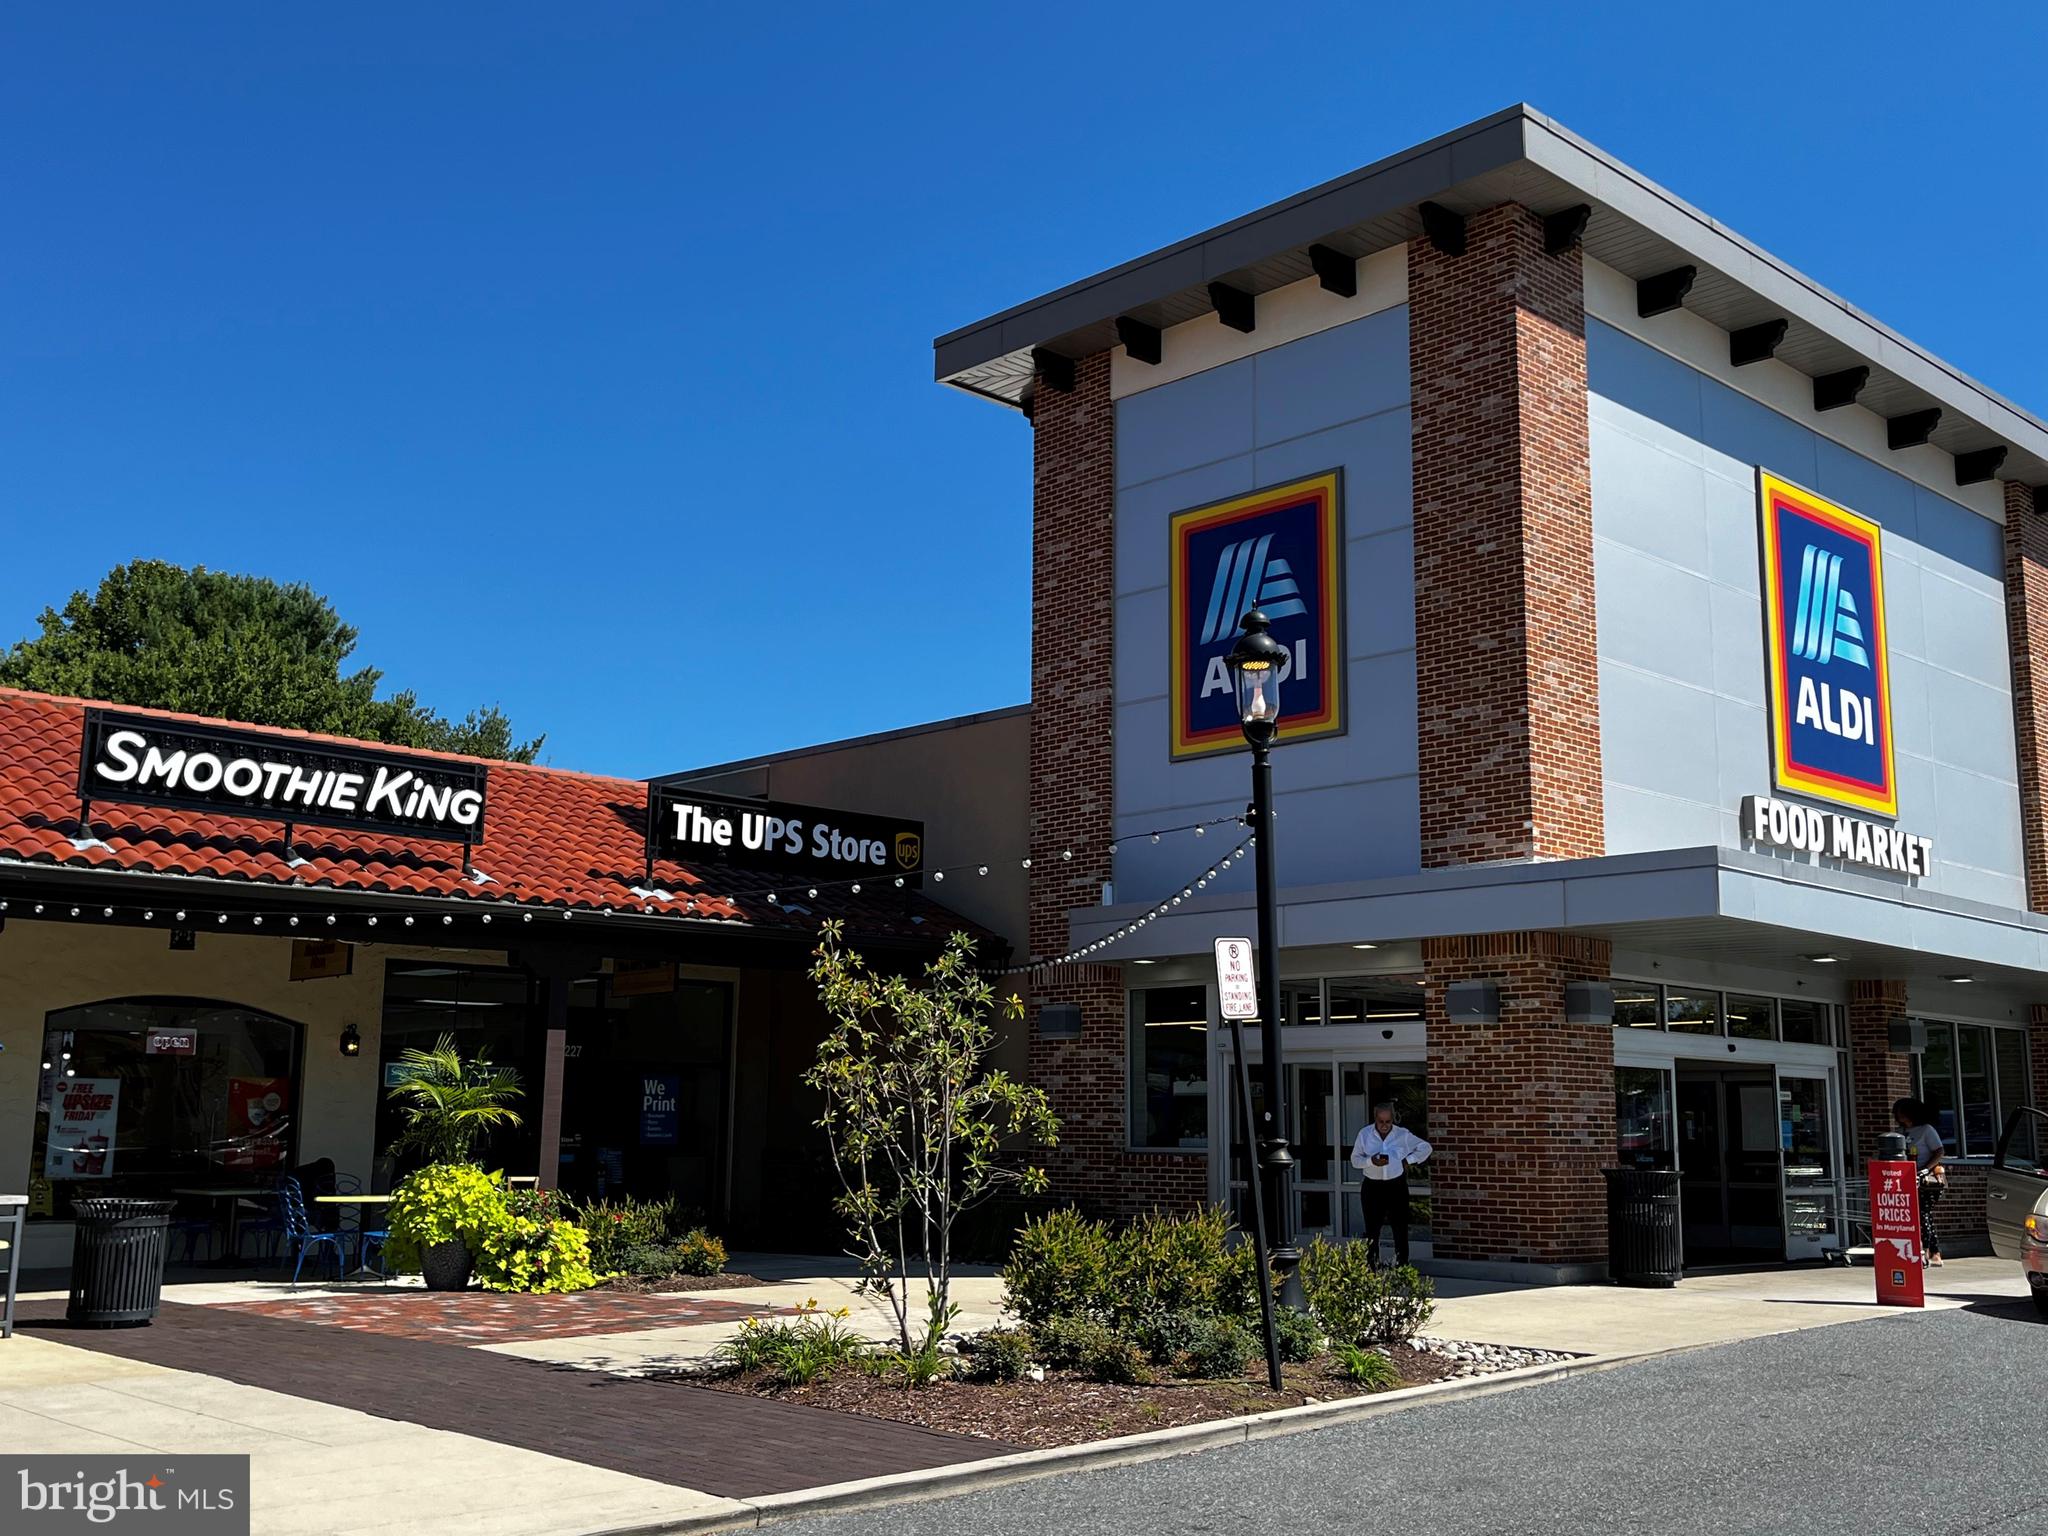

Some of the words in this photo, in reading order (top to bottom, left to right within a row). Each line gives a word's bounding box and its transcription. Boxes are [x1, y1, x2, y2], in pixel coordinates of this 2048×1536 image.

[1201, 638, 1306, 698] AI
[1796, 675, 1875, 746] ALDI
[96, 731, 363, 811] SMOOTHIE
[672, 803, 732, 847] The
[741, 812, 804, 855] UPS
[812, 823, 886, 865] Store
[1753, 795, 1825, 853] FOOD
[1832, 814, 1933, 877] MARKET
[898, 842, 919, 863] ups
[1230, 960, 1241, 972] NO
[1225, 974, 1248, 982] PARKING
[1224, 992, 1252, 1001] STANDING
[153, 1035, 190, 1051] open
[565, 1045, 582, 1057] 227
[72, 1083, 95, 1094] FREE
[644, 1079, 666, 1096] We
[642, 1096, 676, 1112] Print
[63, 1110, 96, 1122] FRIDAY
[1882, 1169, 1902, 1177] Voted
[1883, 1178, 1902, 1193] #1
[1877, 1193, 1911, 1208] LOWEST
[1878, 1208, 1911, 1223] PRICES
[1884, 1224, 1916, 1233] Maryland
